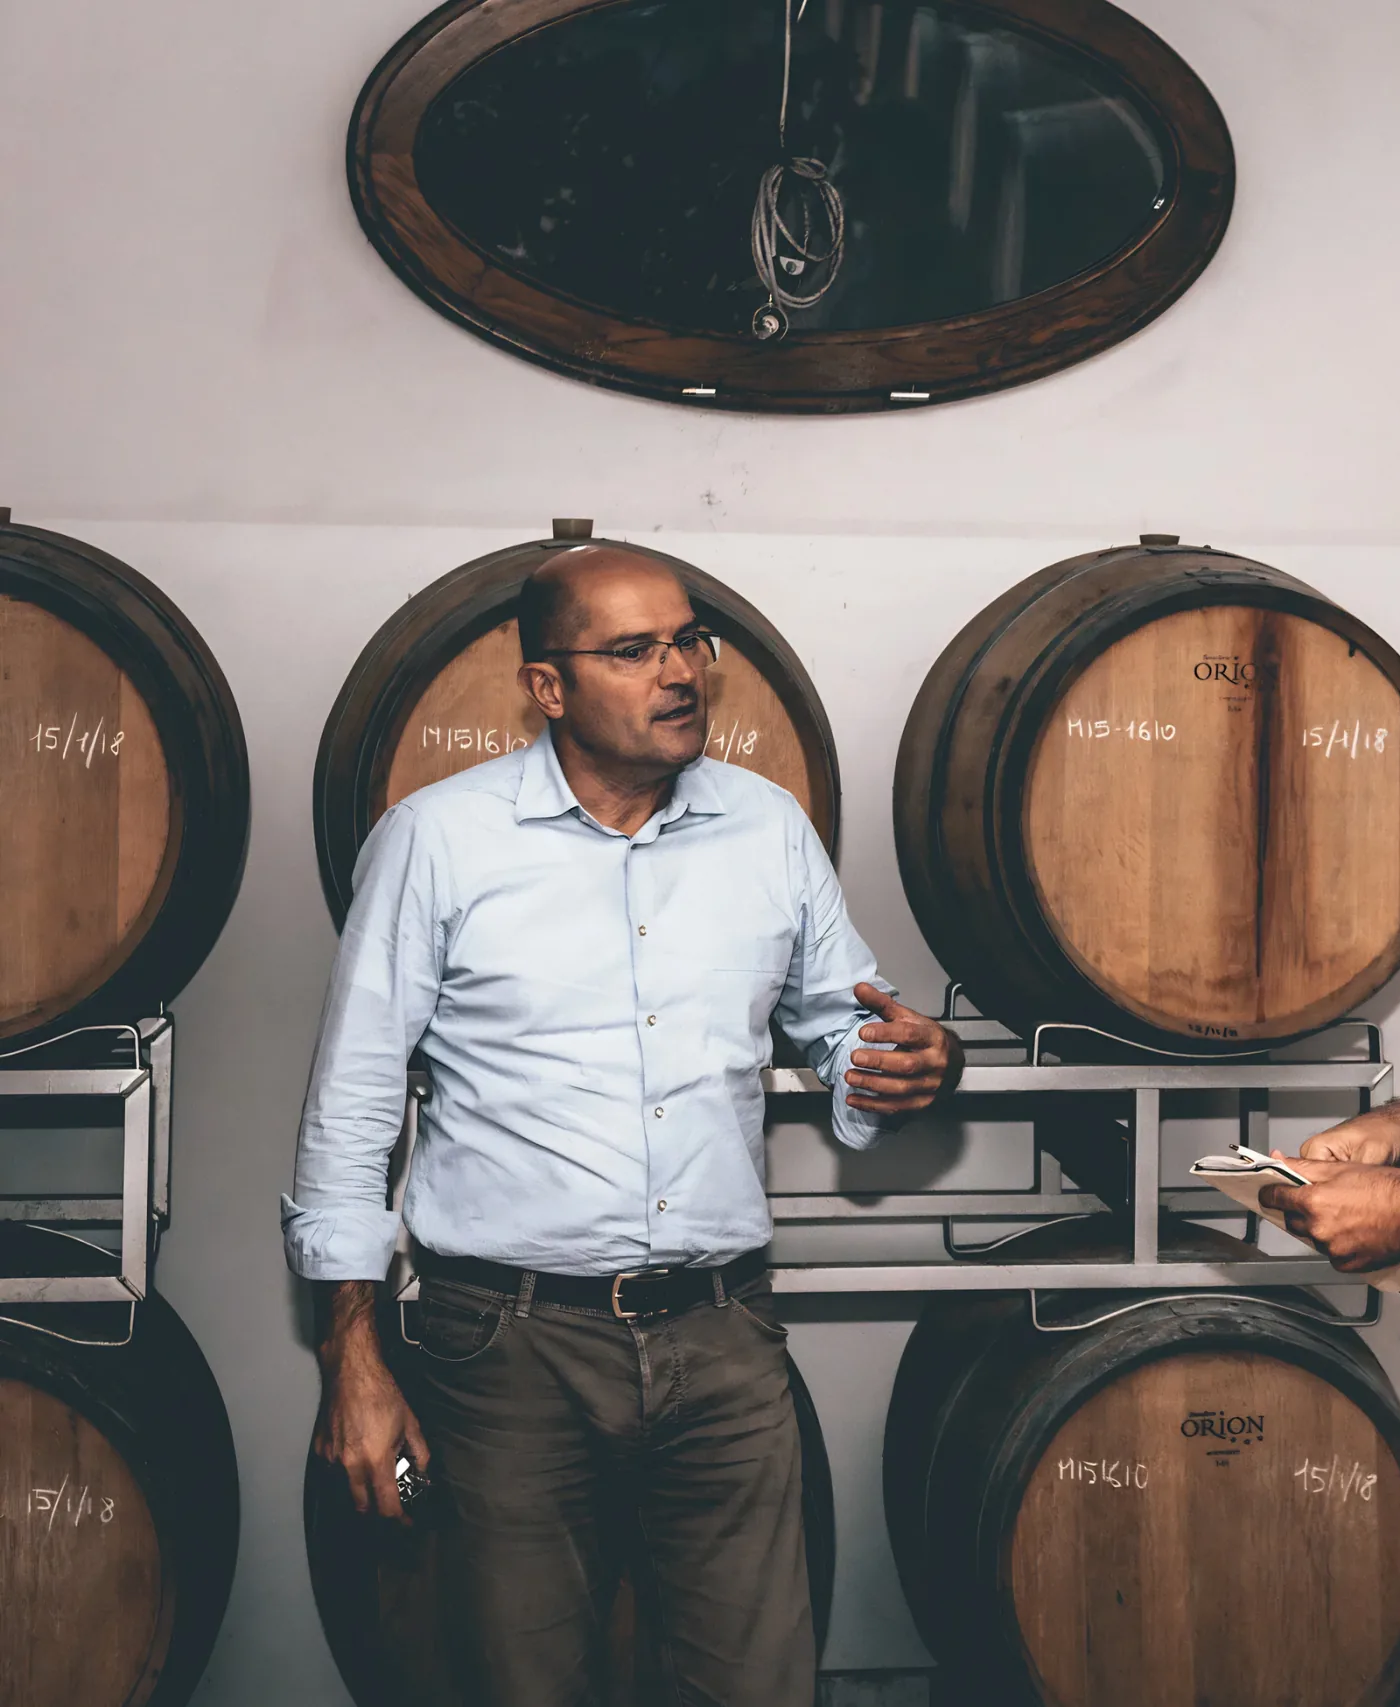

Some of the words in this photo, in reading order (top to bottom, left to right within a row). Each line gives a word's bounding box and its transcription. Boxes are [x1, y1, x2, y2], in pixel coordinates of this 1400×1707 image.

[28, 711, 125, 769] 15/1/18
[1067, 718, 1177, 741] M15-1610
[1302, 719, 1389, 760] 15/1/18
[1181, 1414, 1265, 1440] ORION
[1058, 1457, 1149, 1489] M151610
[1293, 1454, 1378, 1502] 15/1/18
[27, 1473, 115, 1532] 15/1/18
